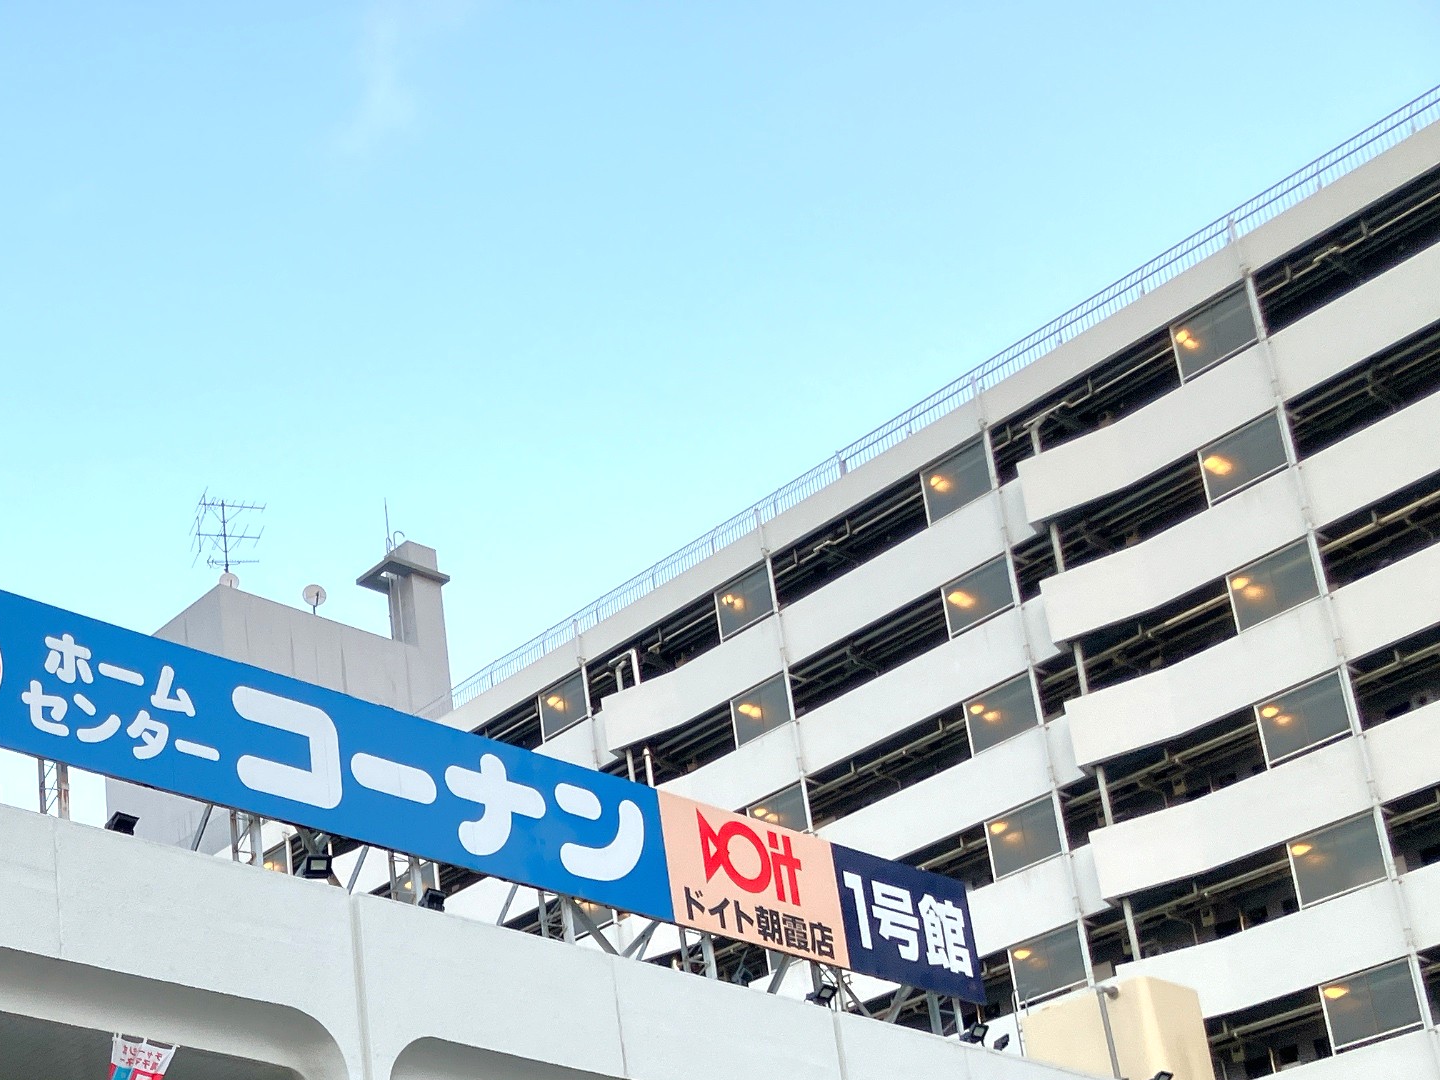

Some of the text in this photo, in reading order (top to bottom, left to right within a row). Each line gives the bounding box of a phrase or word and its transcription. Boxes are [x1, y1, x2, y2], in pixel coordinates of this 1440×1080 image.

[44, 633, 195, 718] ホーム
[21, 679, 221, 761] センター
[231, 685, 644, 882] コーナン
[683, 886, 836, 961] ドイト朝霞店
[843, 869, 972, 978] 1号館
